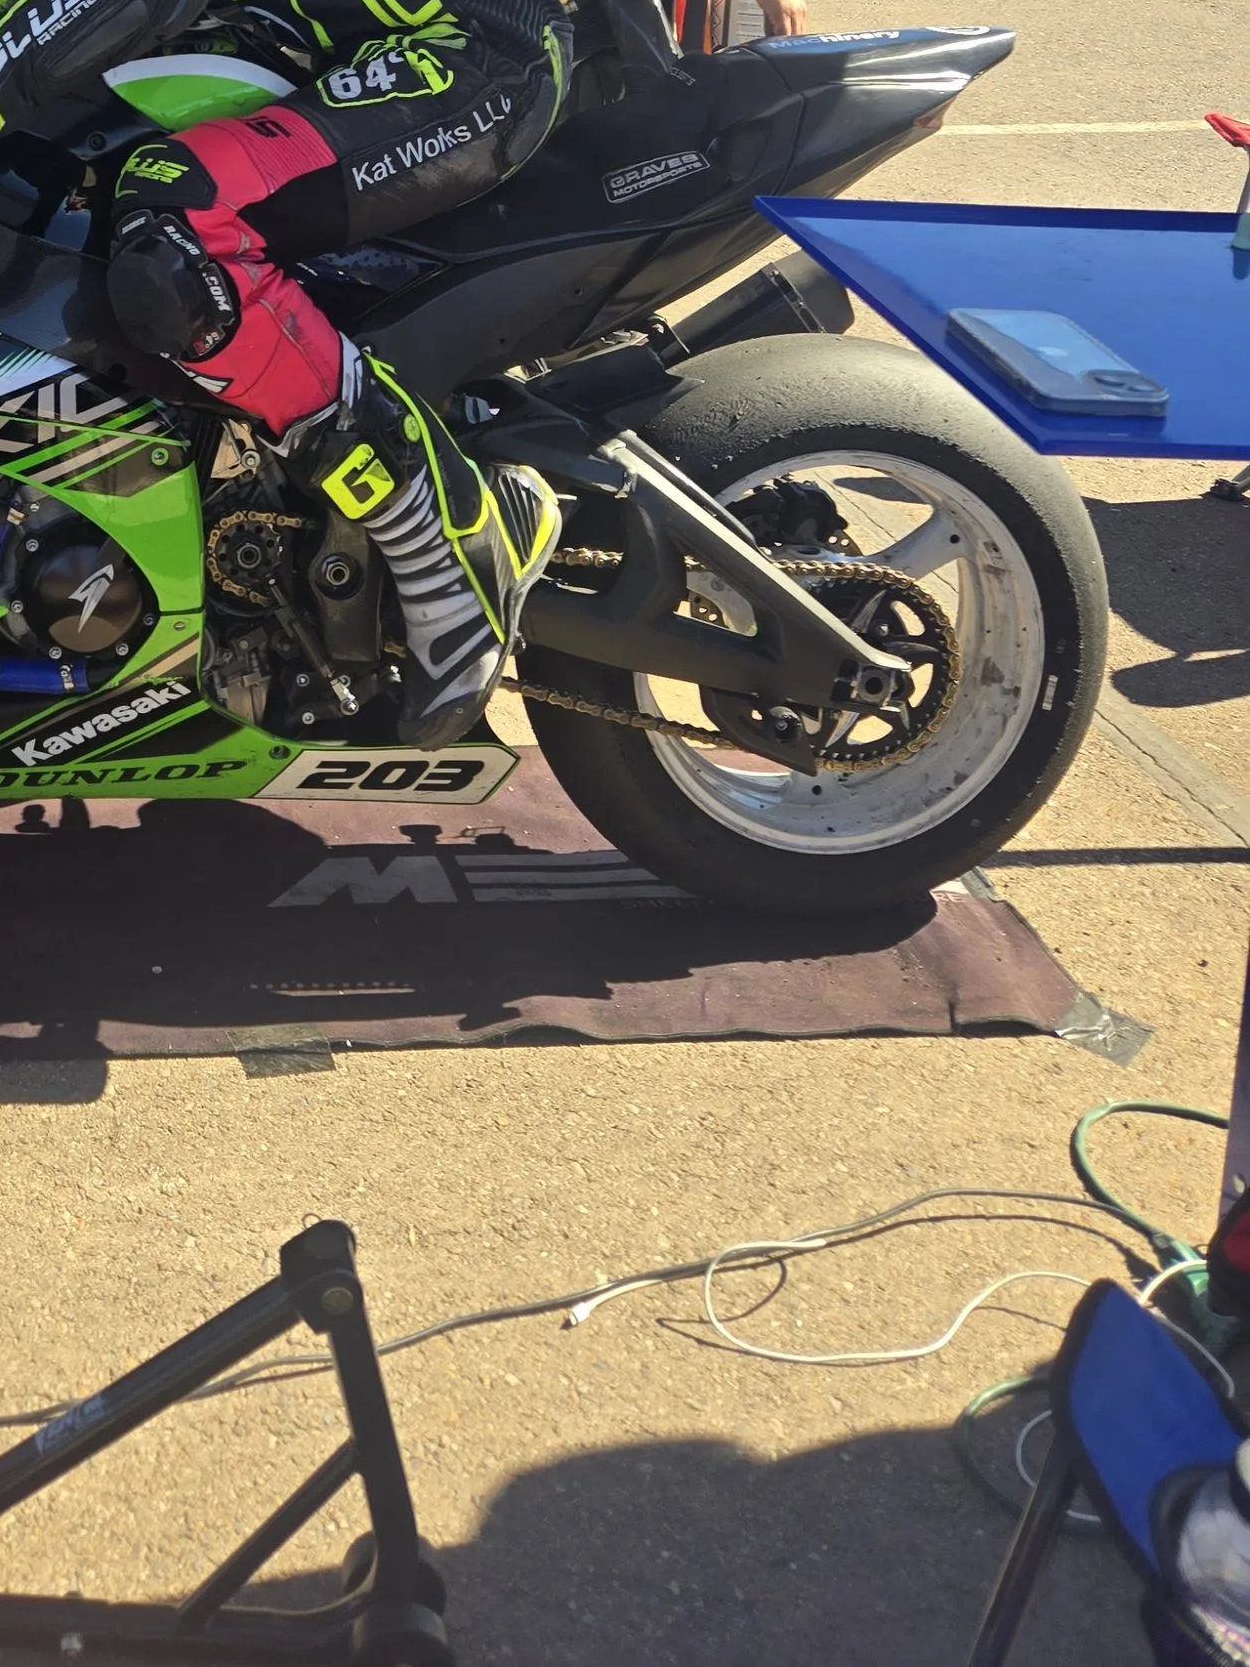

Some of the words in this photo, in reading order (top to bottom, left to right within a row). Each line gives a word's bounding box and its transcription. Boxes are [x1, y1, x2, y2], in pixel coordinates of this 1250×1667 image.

[351, 155, 398, 191] Kat
[610, 153, 700, 189] GRAVES
[612, 161, 703, 198] MOTORSPORTS
[10, 680, 192, 768] Kawasaki
[296, 760, 485, 792] 203
